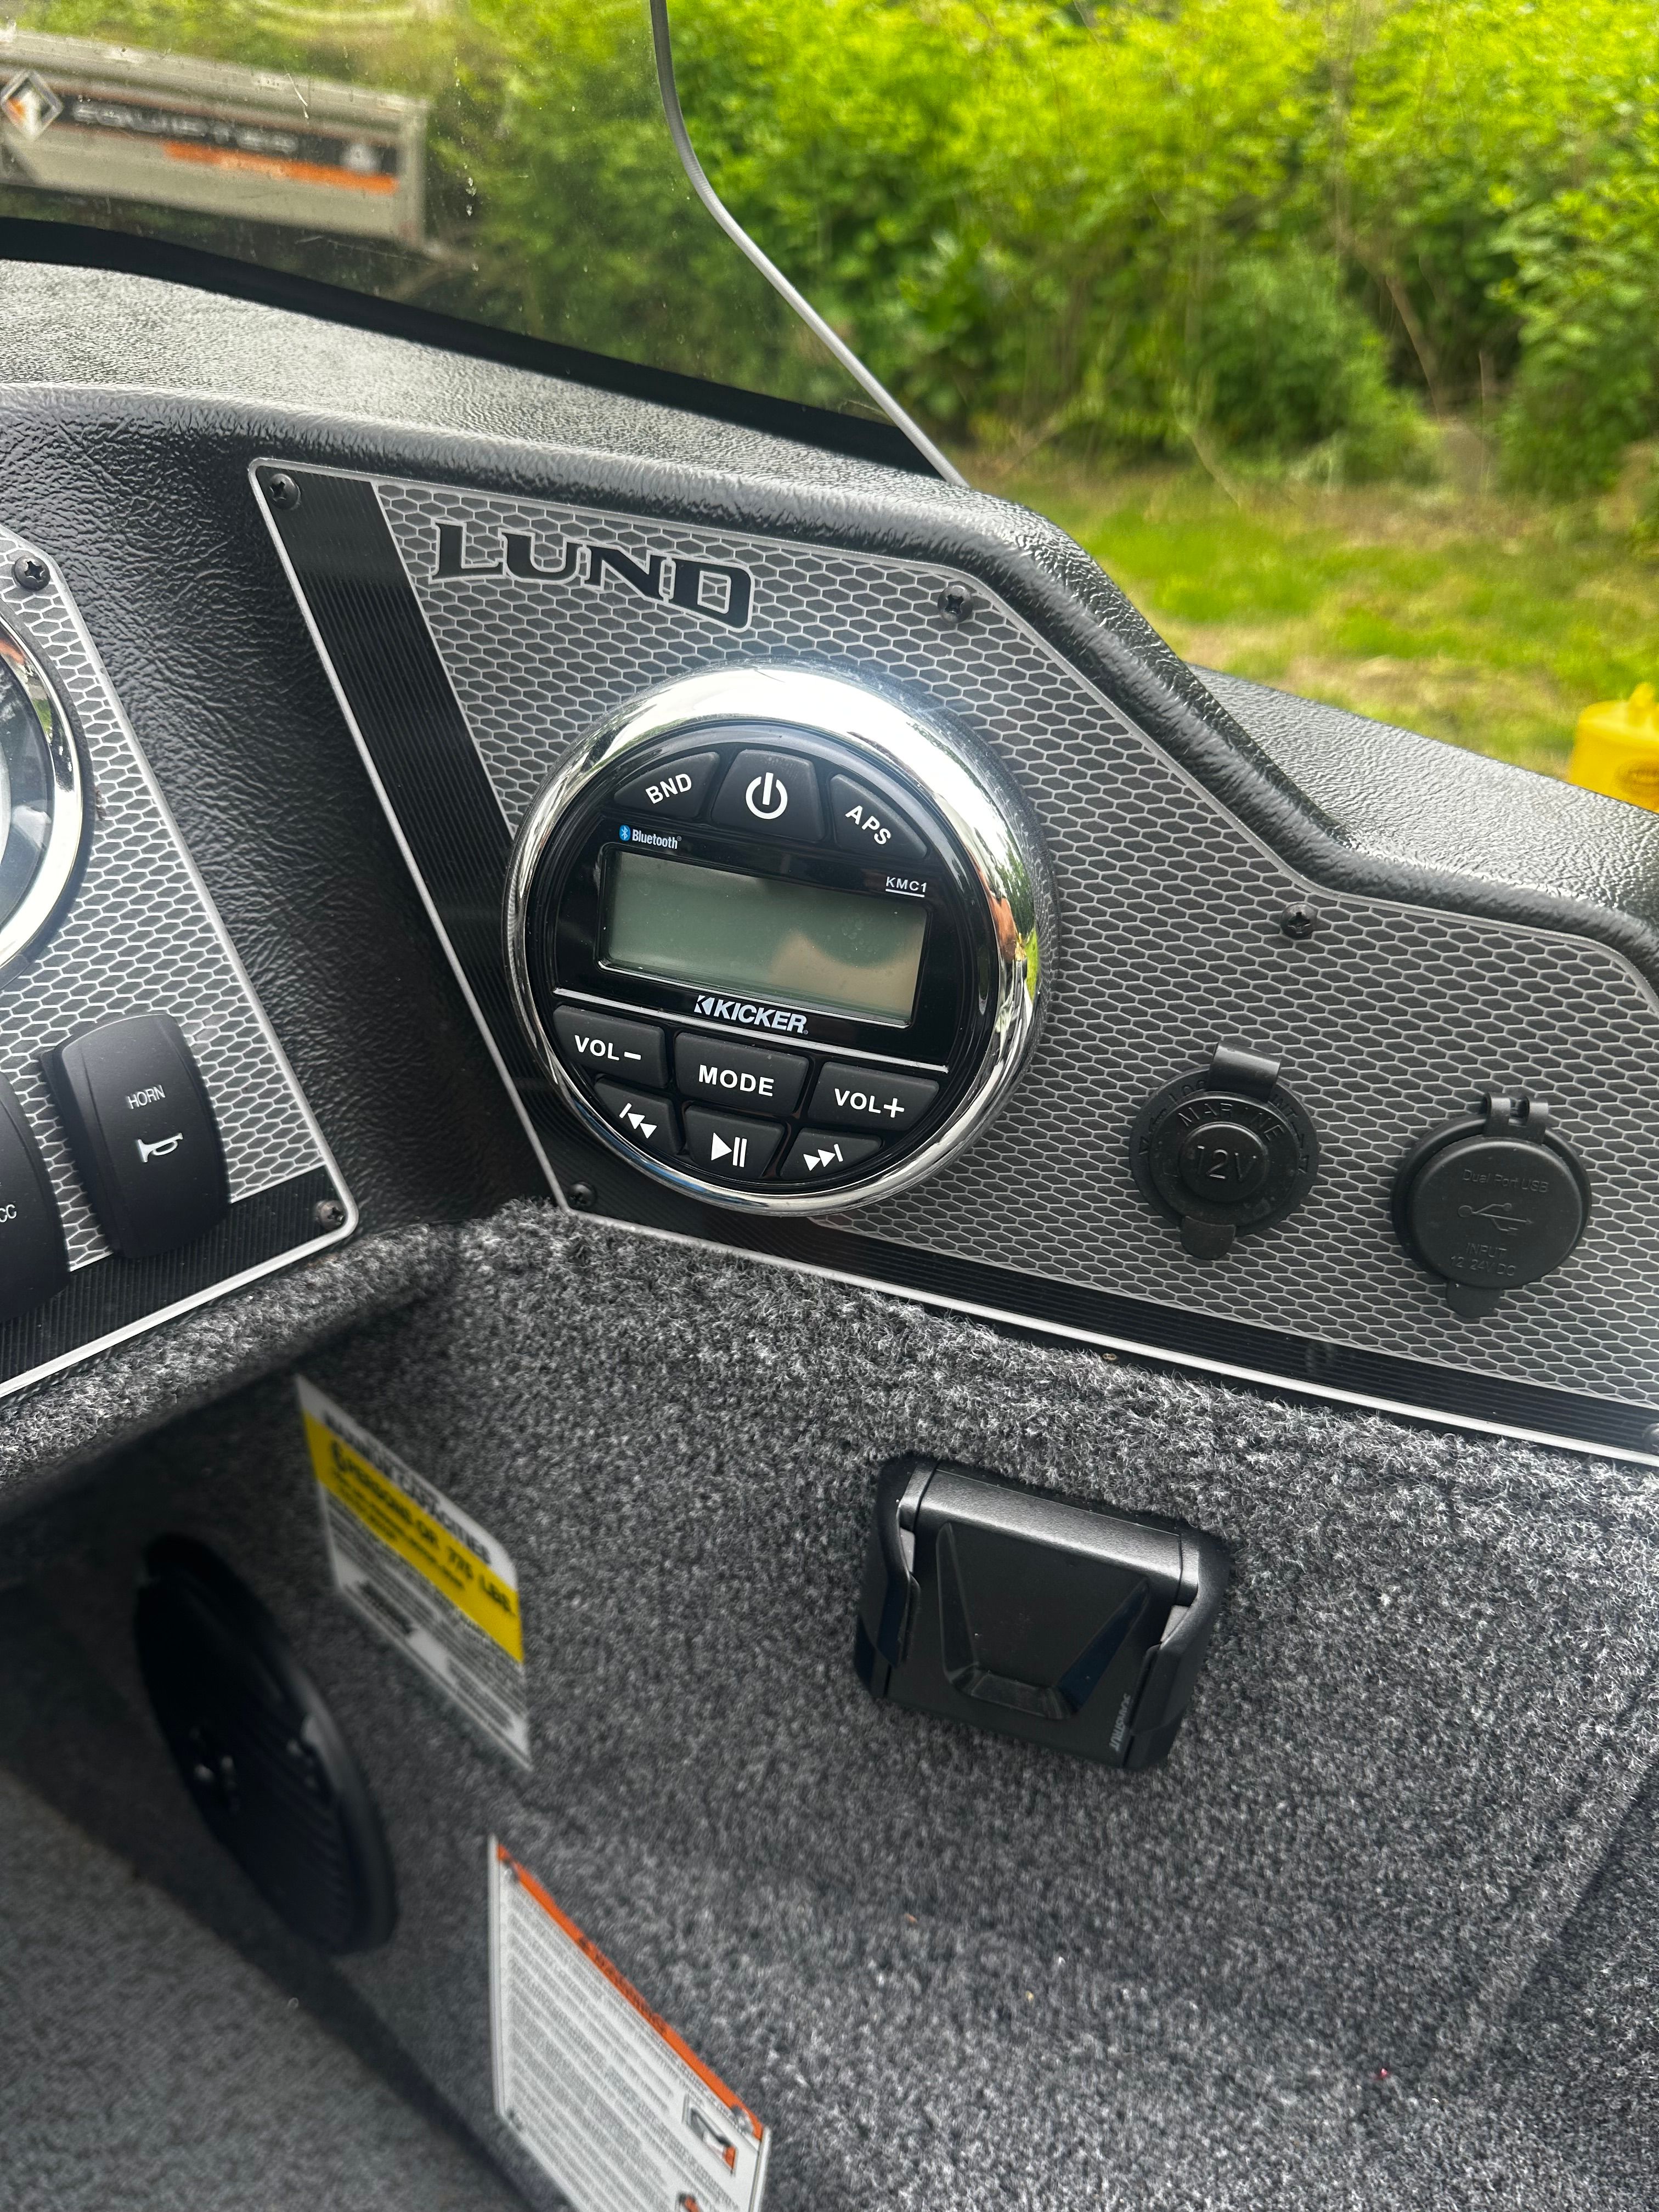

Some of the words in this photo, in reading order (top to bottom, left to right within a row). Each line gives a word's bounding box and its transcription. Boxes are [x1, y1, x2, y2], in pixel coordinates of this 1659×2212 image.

[429, 518, 755, 633] LUND
[645, 773, 692, 804] BND
[845, 805, 891, 845] APS
[885, 876, 927, 893] KMC1
[128, 1084, 166, 1109] HORN
[698, 1065, 774, 1097] MODE
[834, 1088, 905, 1118] VOL+
[1178, 1102, 1286, 1143] MARNE
[1196, 1144, 1259, 1182] 12V
[1462, 1169, 1491, 1183] Dual
[1521, 1178, 1550, 1193] USB
[1465, 1243, 1508, 1260] INPUT
